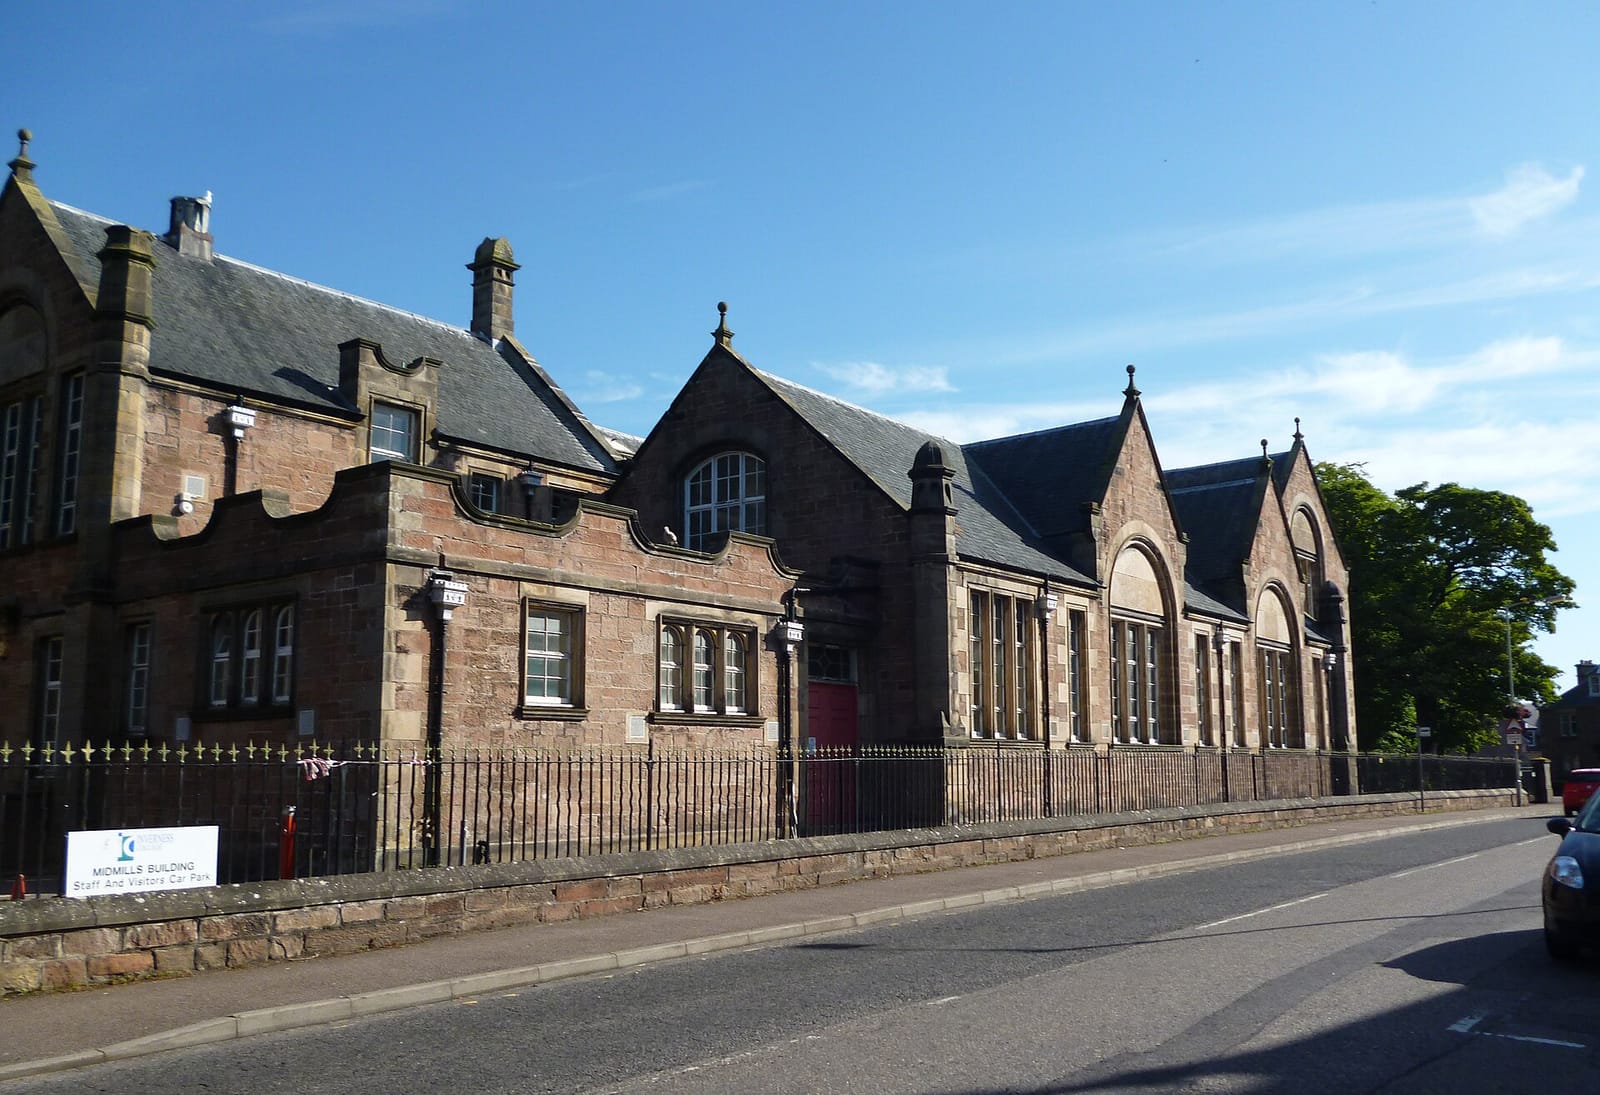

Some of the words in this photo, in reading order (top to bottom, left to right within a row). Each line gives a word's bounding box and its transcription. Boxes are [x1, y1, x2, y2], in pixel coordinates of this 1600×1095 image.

[92, 865, 143, 877] MIDMILLS
[148, 862, 195, 874] BUILDING
[73, 881, 100, 891] Staff
[105, 879, 124, 888] And
[128, 876, 165, 887] Visitors
[169, 874, 186, 884] Car
[190, 872, 211, 882] Park
